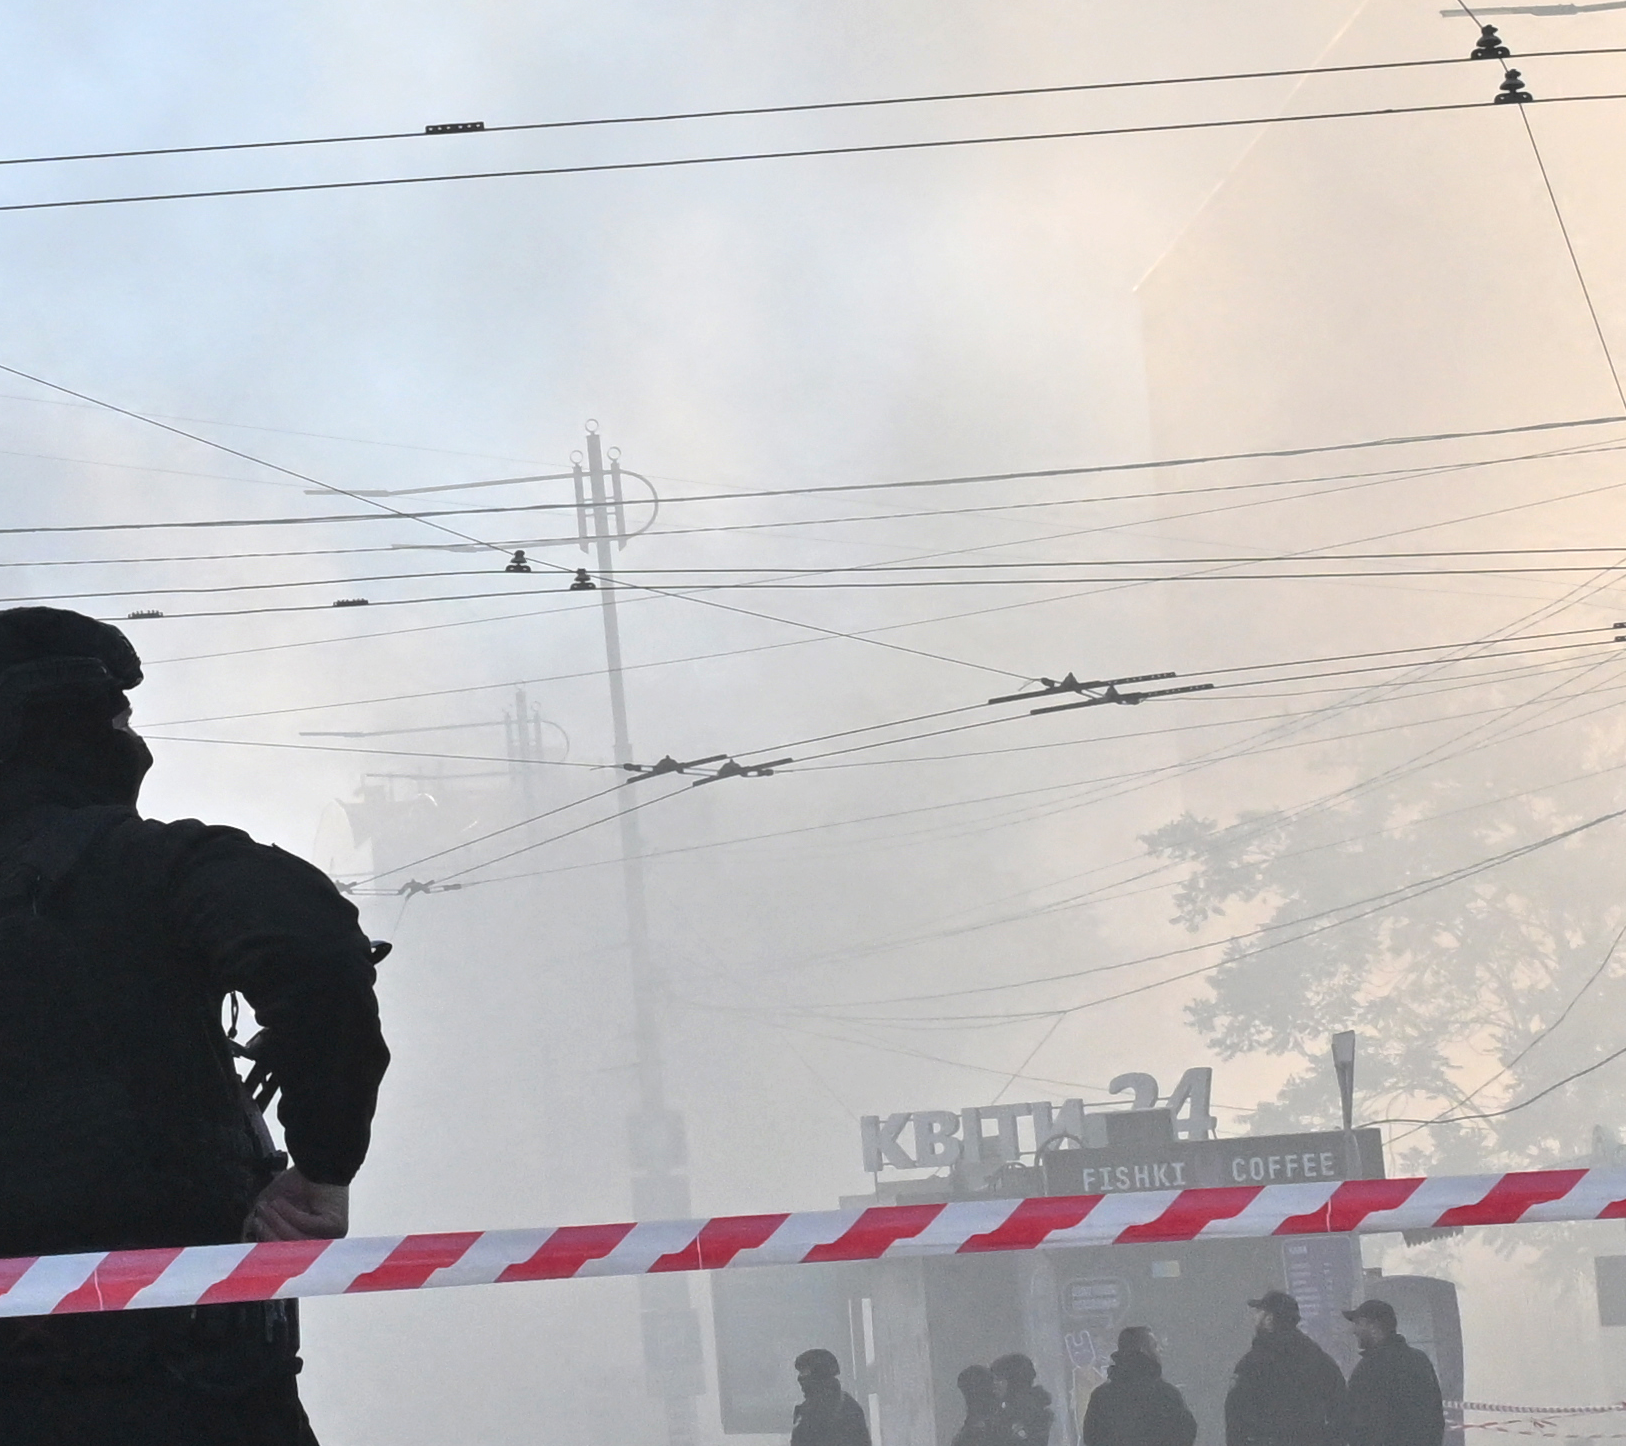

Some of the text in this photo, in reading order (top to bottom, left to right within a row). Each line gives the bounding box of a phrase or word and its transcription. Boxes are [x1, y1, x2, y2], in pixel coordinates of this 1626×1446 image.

[861, 1066, 1218, 1172] КВІТИ 24
[1082, 1151, 1335, 1192] FISHKI COFFEE
